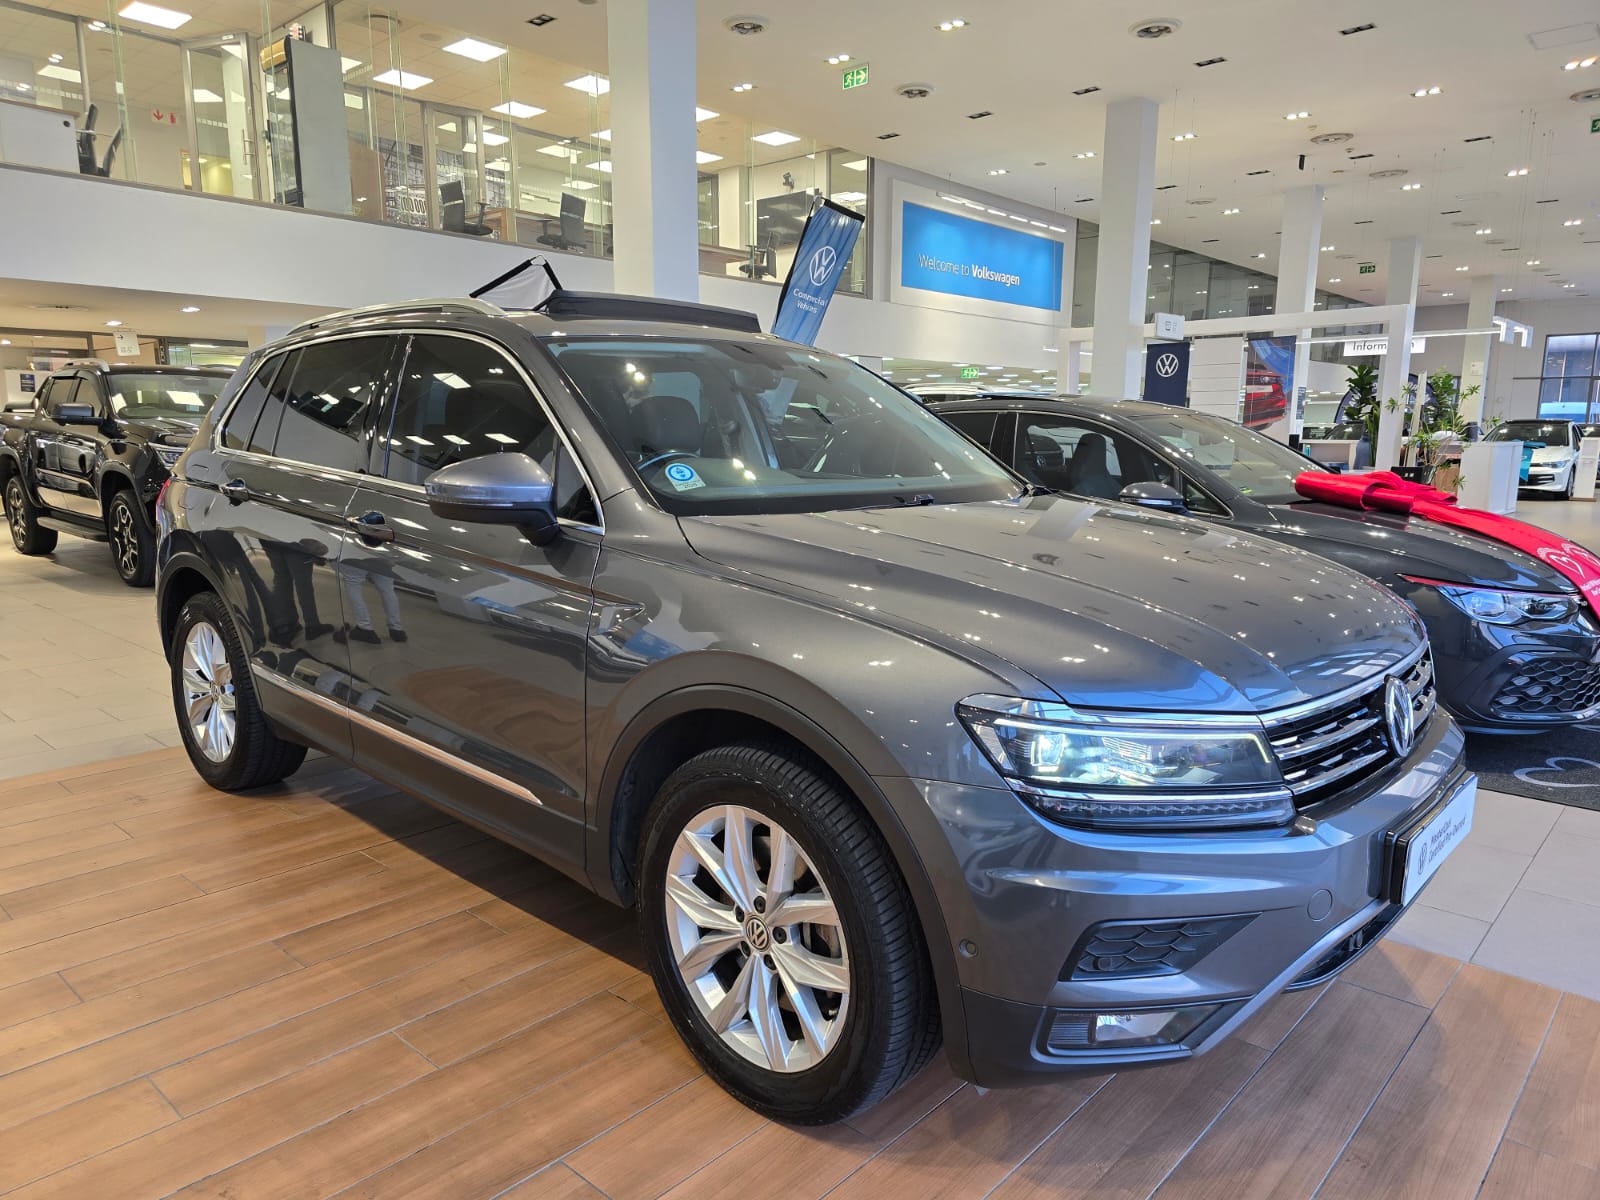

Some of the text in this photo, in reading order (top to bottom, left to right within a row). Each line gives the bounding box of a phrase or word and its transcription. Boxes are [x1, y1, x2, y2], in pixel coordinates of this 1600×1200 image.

[919, 254, 1020, 287] Welcome to Volkswagen
